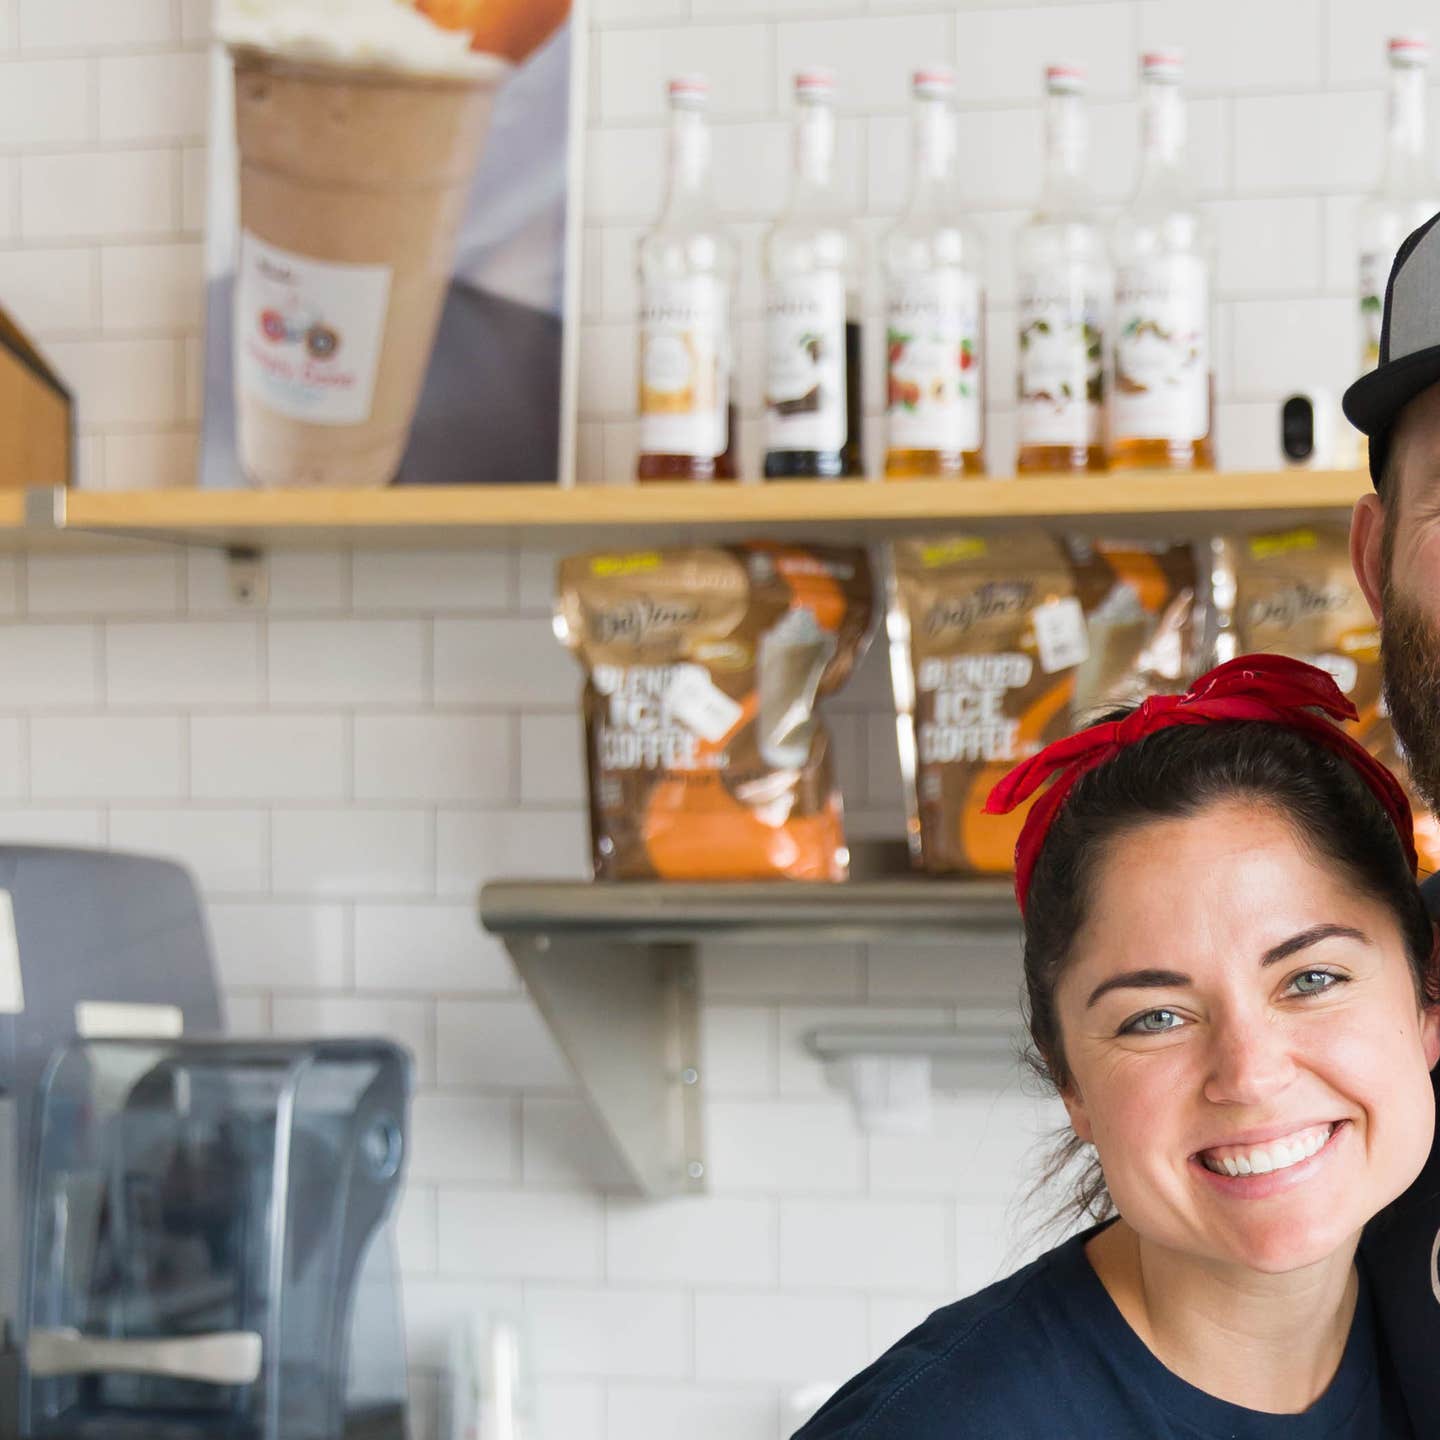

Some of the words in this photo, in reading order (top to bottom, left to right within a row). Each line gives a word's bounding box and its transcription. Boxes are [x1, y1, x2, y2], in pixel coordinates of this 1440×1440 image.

[935, 691, 1003, 728] ICE
[599, 731, 696, 770] COFFEE
[920, 720, 1018, 763] COFFEE
